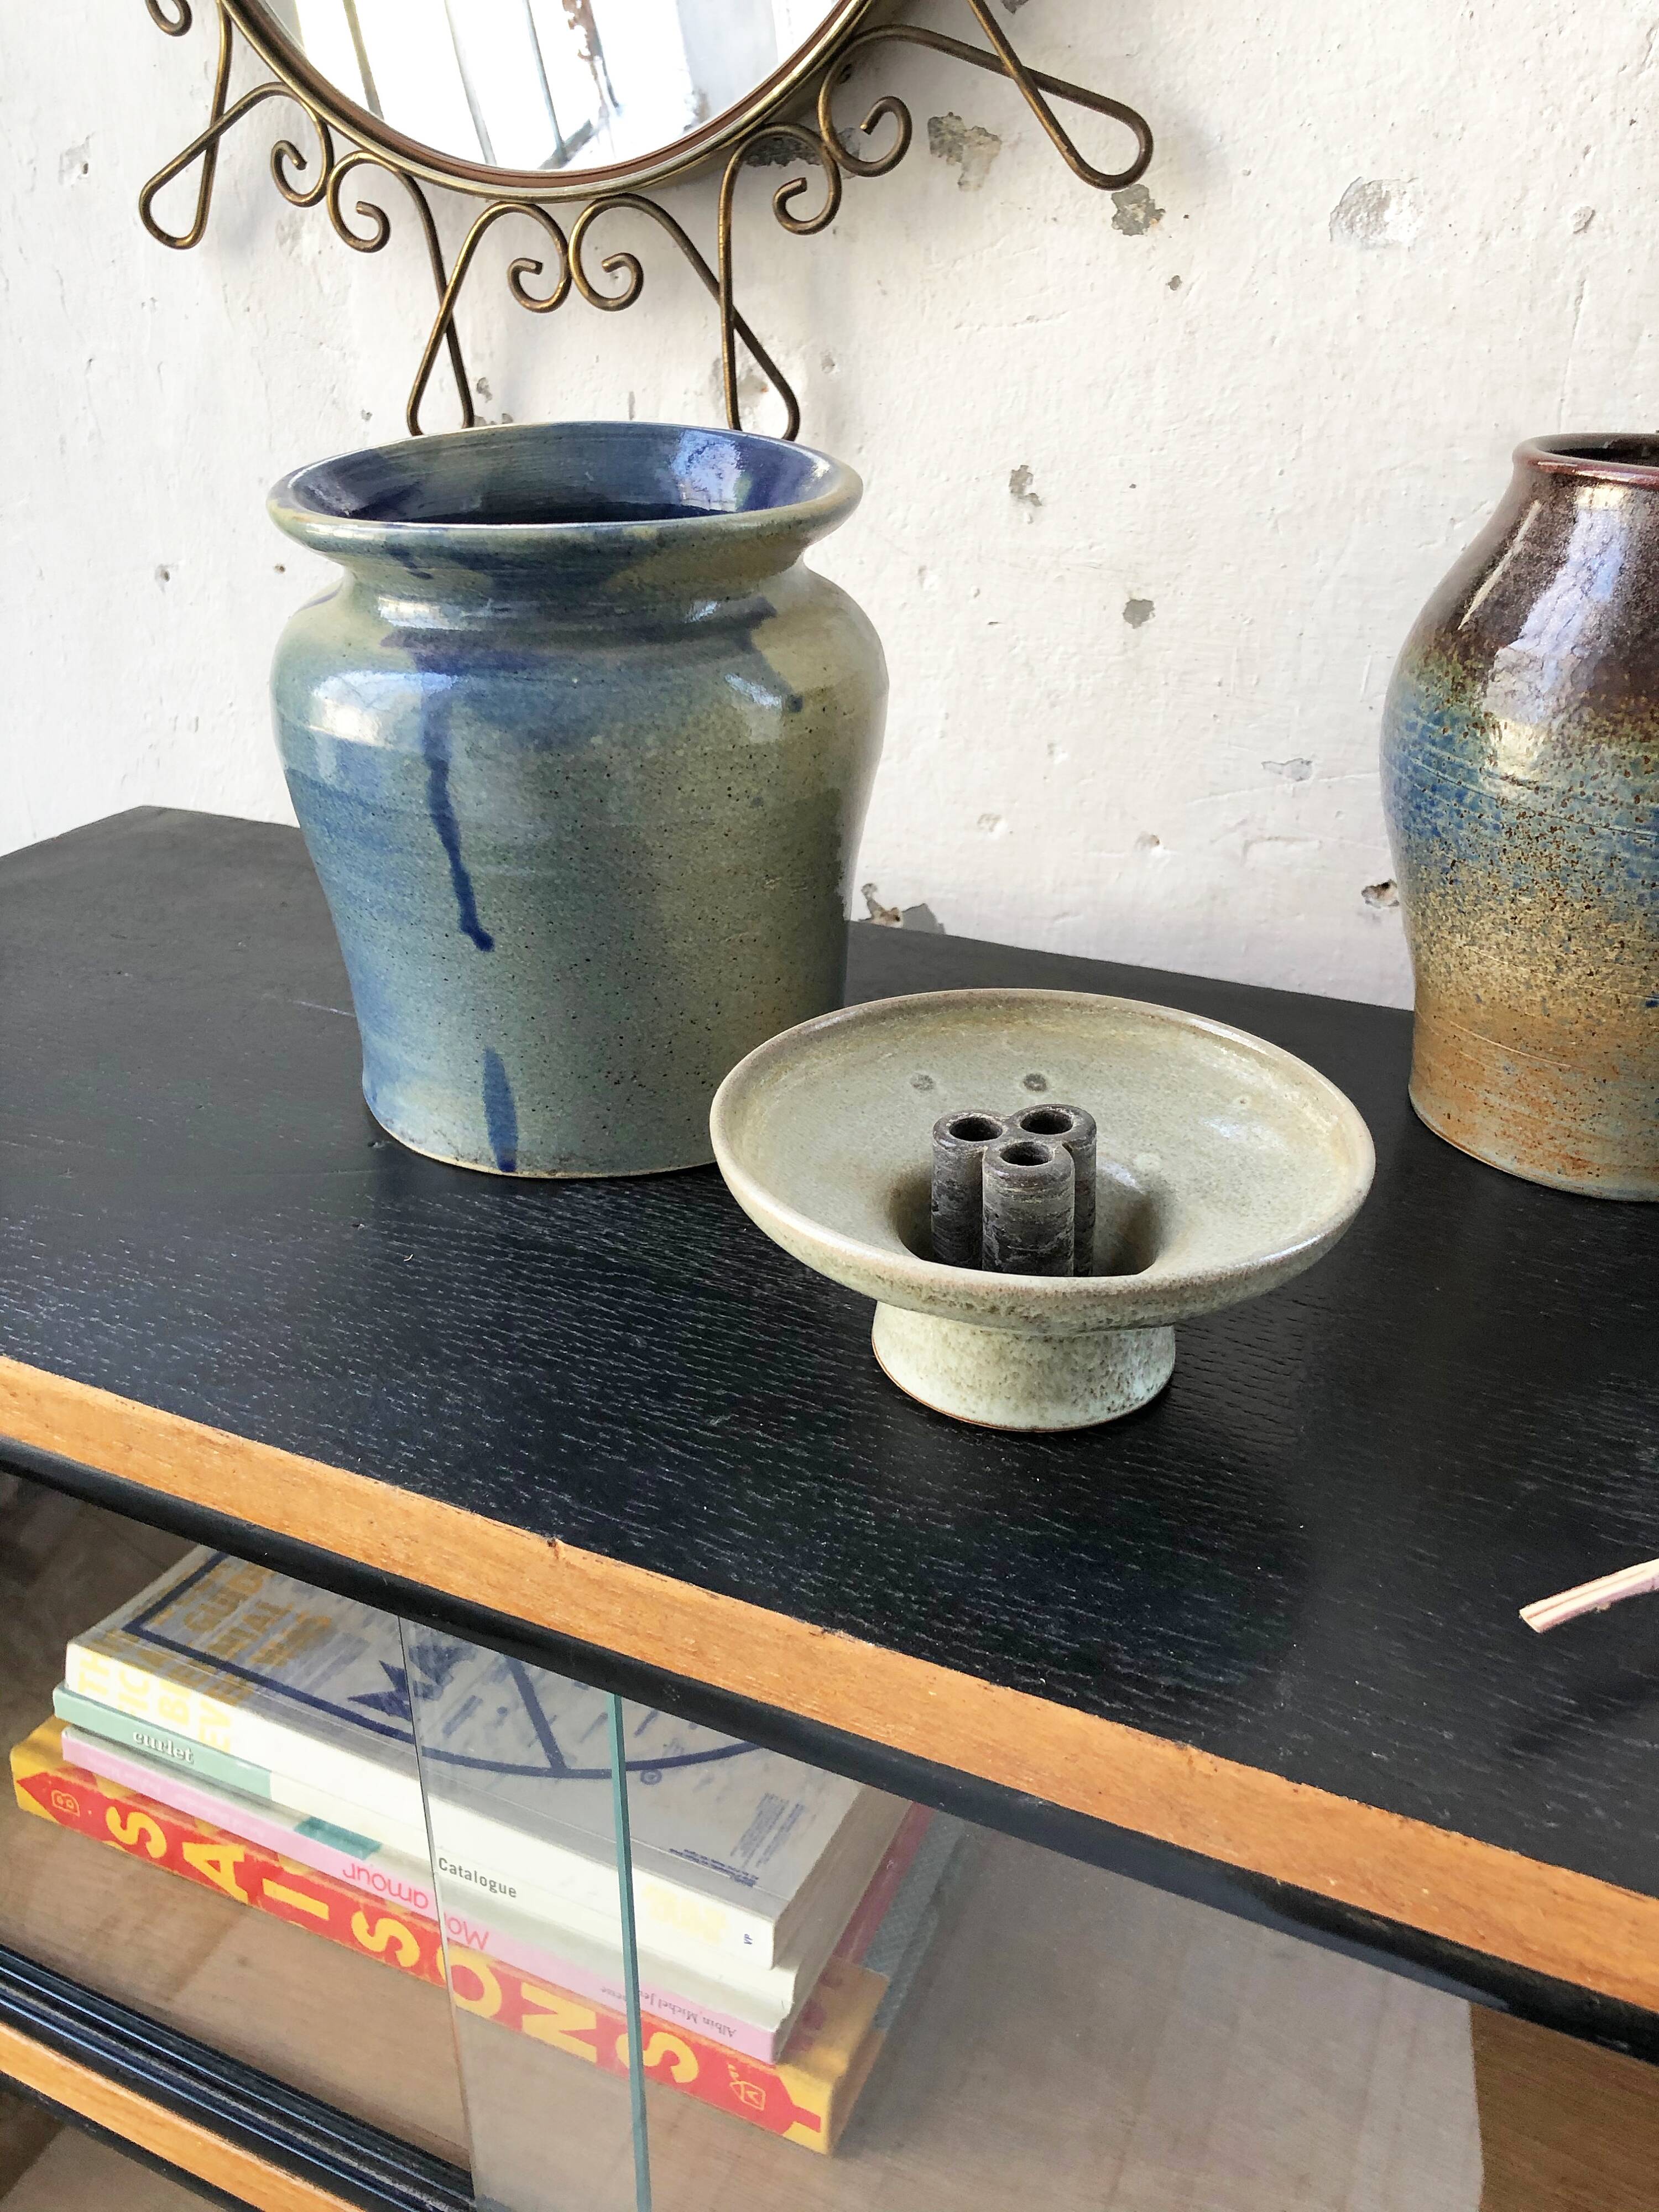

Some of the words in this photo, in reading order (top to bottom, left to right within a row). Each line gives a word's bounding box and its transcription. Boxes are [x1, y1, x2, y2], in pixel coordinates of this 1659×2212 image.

[342, 1863, 429, 1910] amour
[439, 1857, 517, 1898] Catalogue
[658, 1997, 698, 2024] Michel
[702, 2016, 737, 2038] Albin
